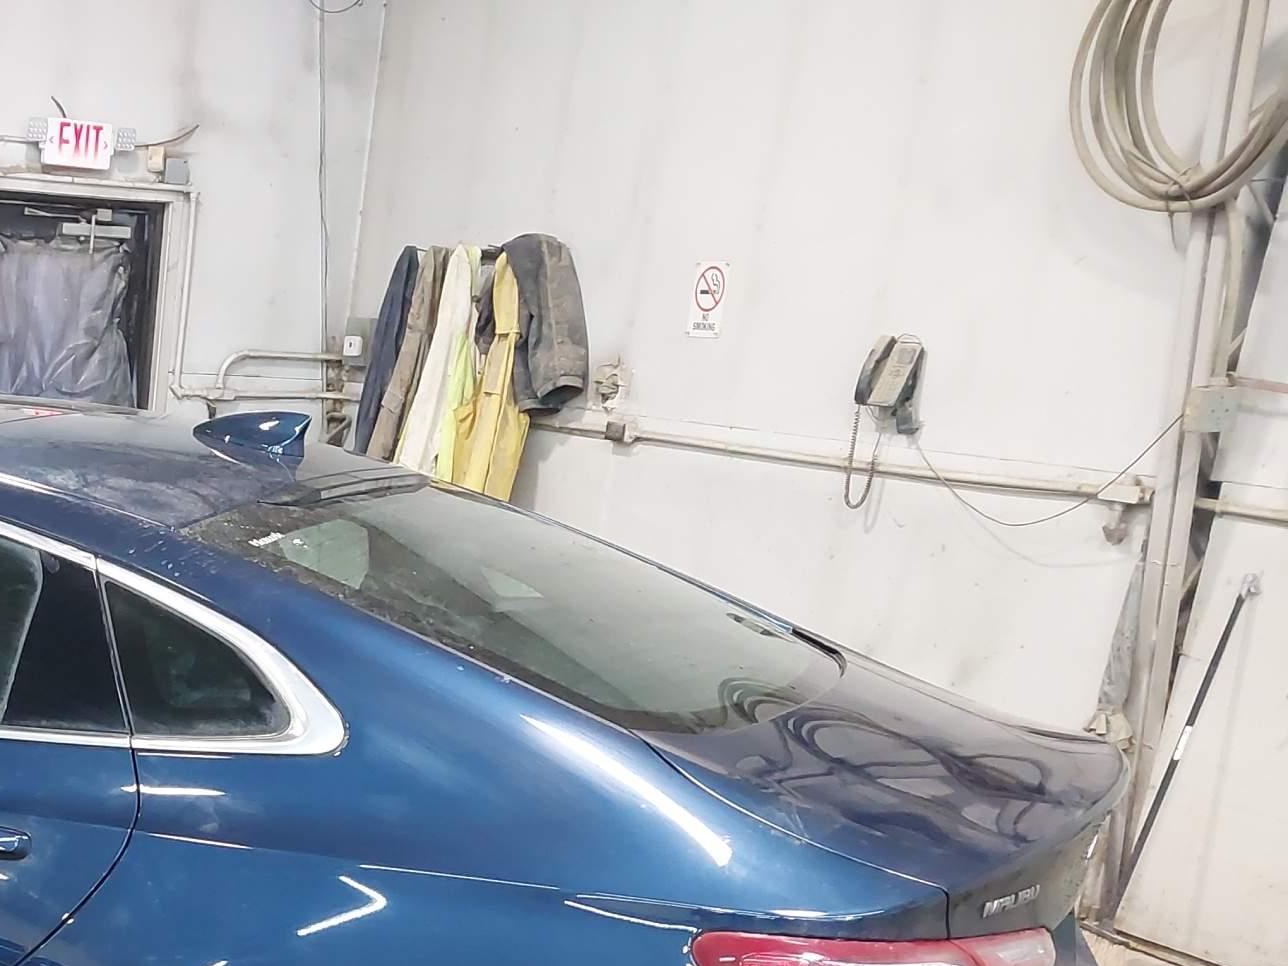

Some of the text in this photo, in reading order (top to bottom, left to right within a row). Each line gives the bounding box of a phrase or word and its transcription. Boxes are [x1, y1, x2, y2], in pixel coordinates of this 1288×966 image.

[59, 121, 103, 159] EXIT
[692, 321, 716, 331] SMOKING
[983, 884, 1041, 918] MALIBU
